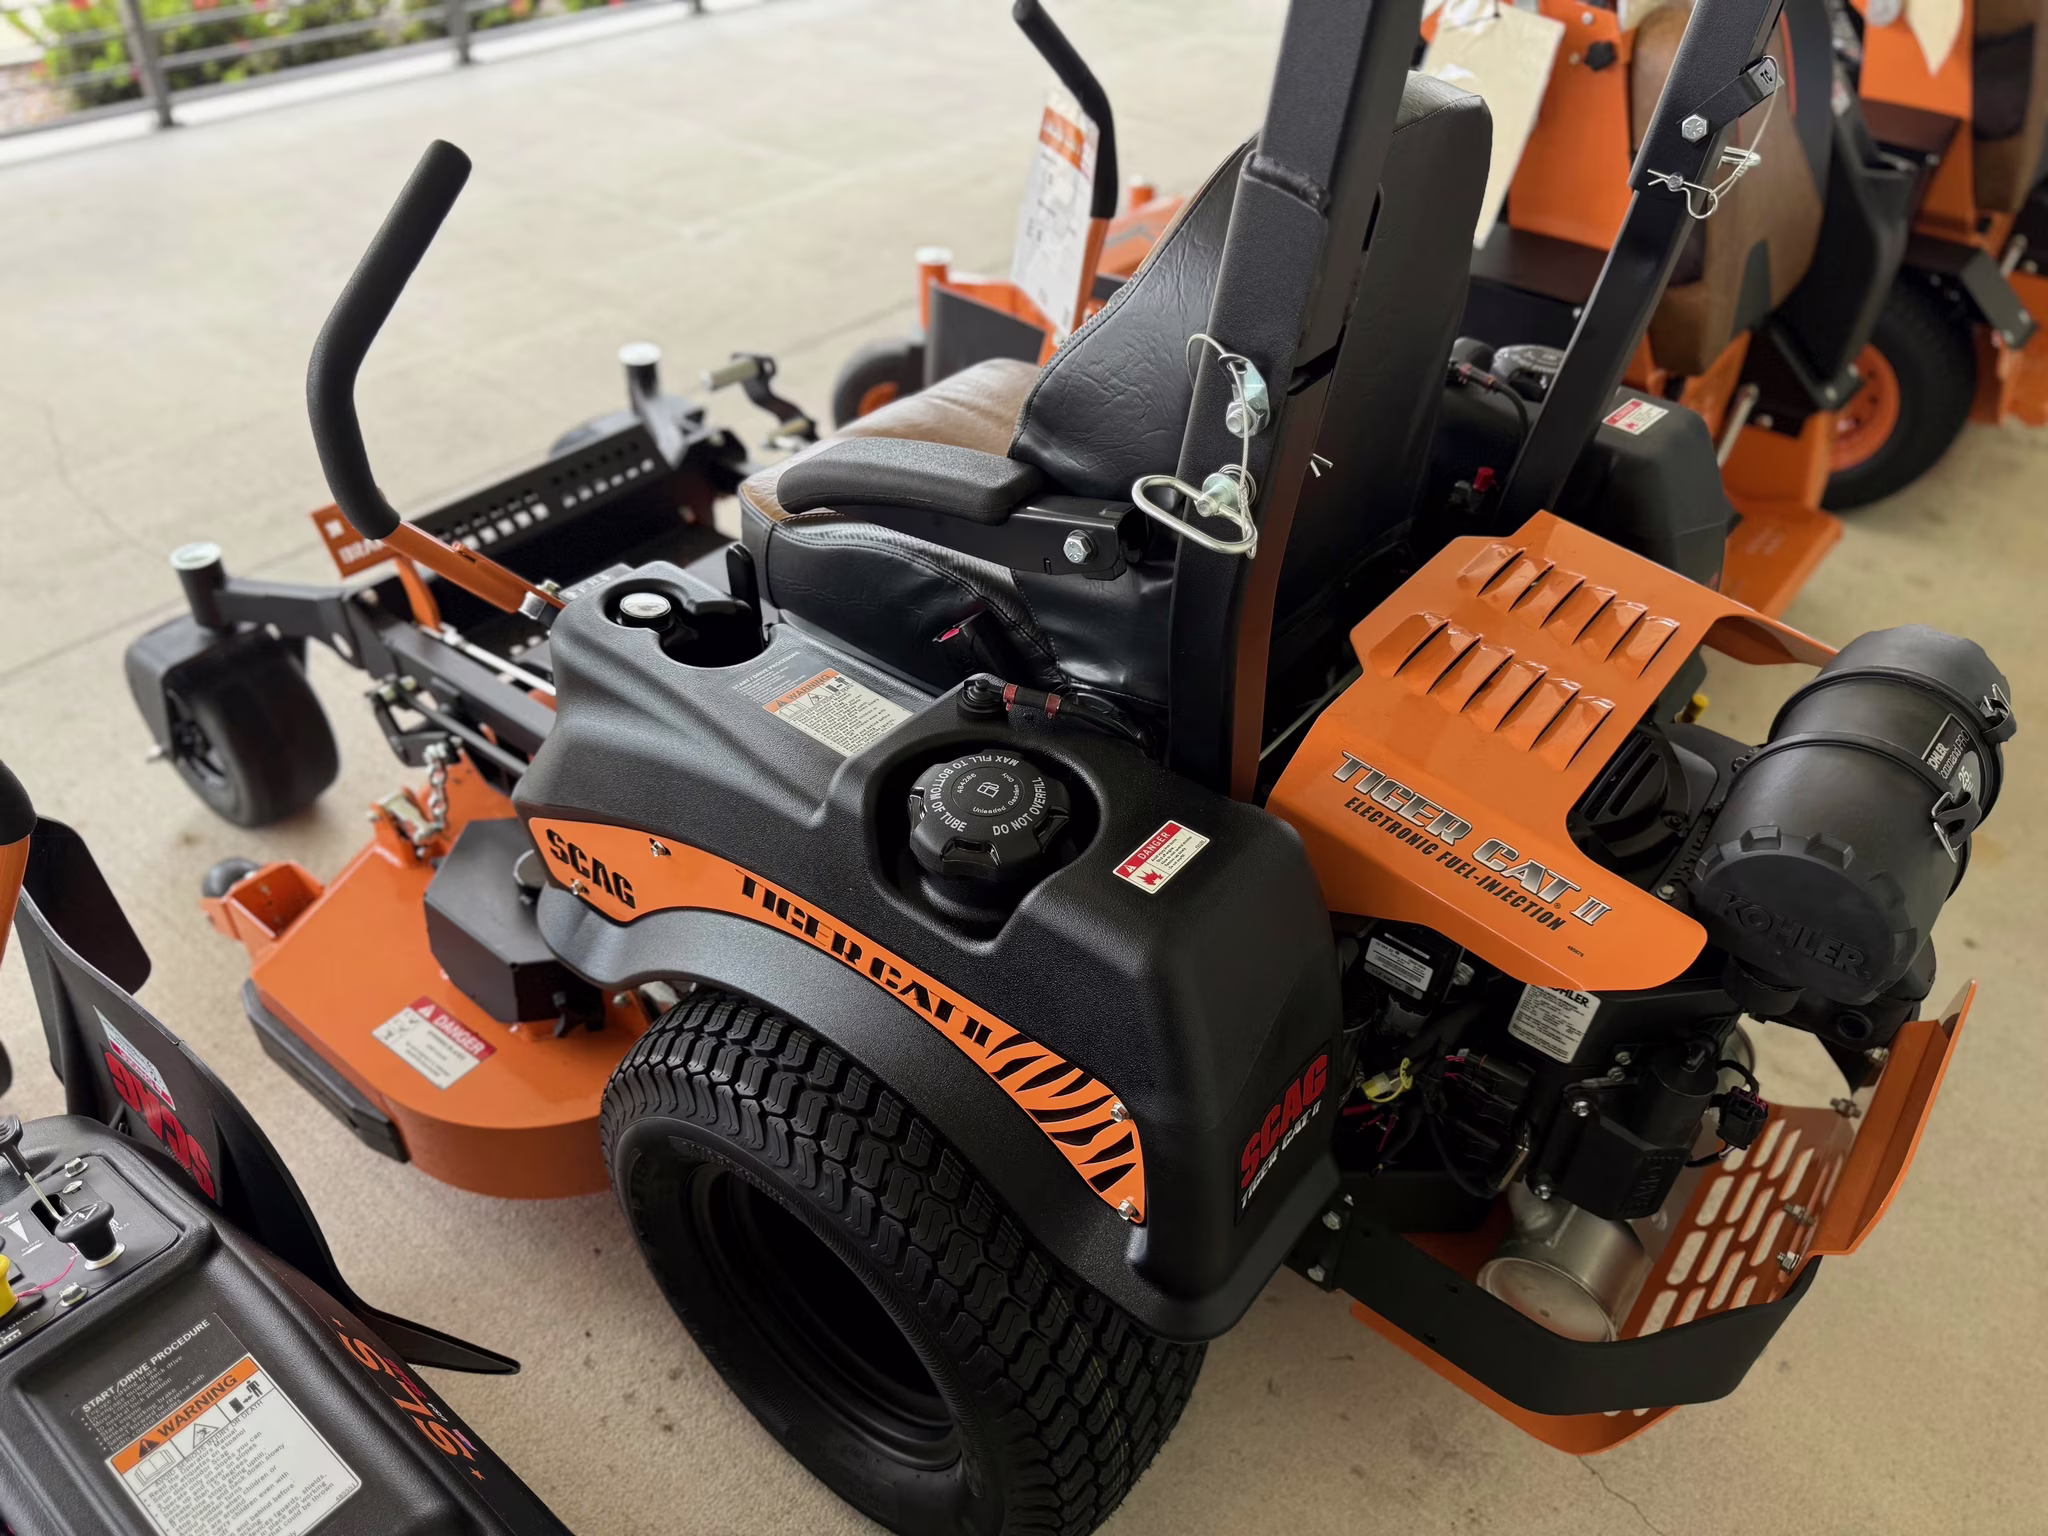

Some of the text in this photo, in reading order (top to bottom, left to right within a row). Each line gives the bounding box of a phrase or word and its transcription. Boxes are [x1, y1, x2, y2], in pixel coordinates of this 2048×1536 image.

[786, 674, 830, 701] WARNING
[1940, 729, 1970, 779] ommand PRO
[930, 755, 1020, 833] MAX FILL TO BOTTOM OF TUBE
[972, 805, 1007, 814] Unleaded
[992, 777, 1047, 836] DO NOT OVERFILL
[1137, 832, 1170, 860] DANGER
[1332, 750, 1612, 926] TIGER CAT II
[546, 828, 636, 909] SCAG
[1344, 797, 1566, 931] ELECTRONIC FUEL-INJECTION
[1717, 890, 1865, 977] KOHLER
[735, 869, 993, 1048] TIGER CAT II
[1549, 987, 1589, 1008] HLER
[432, 1014, 486, 1056] DANGER
[105, 1051, 216, 1200] SCAG
[1241, 1055, 1327, 1188] SCAG
[1241, 1146, 1279, 1209] TIGER
[1282, 1109, 1311, 1150] CAT
[82, 1319, 210, 1414] START/DRIVE PROCEDURE
[138, 1366, 157, 1381] brake
[166, 1355, 182, 1368] drive
[190, 1373, 204, 1385] with
[157, 1388, 176, 1403] brake
[157, 1374, 238, 1438] WARNING
[154, 1469, 175, 1487] AVOID
[207, 1427, 230, 1446] INJURY
[230, 1418, 241, 1427] OR
[241, 1400, 263, 1418] DEATH
[204, 1470, 213, 1479] on
[236, 1441, 249, 1453] you
[249, 1431, 261, 1442] can
[211, 1450, 229, 1465] Scag
[214, 1428, 236, 1447] Manual
[192, 1483, 205, 1495] and
[225, 1460, 234, 1469] on
[235, 1443, 256, 1461] slopes
[210, 1479, 219, 1488] 15
[221, 1458, 248, 1481] degrees
[215, 1488, 228, 1500] and
[229, 1474, 245, 1489] back
[246, 1460, 264, 1475] down
[264, 1443, 285, 1460] slowly
[224, 1494, 241, 1509] when
[242, 1472, 269, 1494] children
[269, 1464, 277, 1472] or
[223, 1498, 246, 1518] around
[225, 1486, 242, 1501] turns
[231, 1497, 258, 1520] children
[258, 1483, 274, 1497] even
[274, 1471, 289, 1484] with
[249, 1501, 272, 1521] behind
[272, 1483, 294, 1502] before
[268, 1513, 287, 1530] place
[287, 1502, 300, 1514] and
[300, 1481, 326, 1504] working
[282, 1509, 302, 1526] could
[301, 1500, 311, 1510] be
[311, 1482, 333, 1501] thrown
